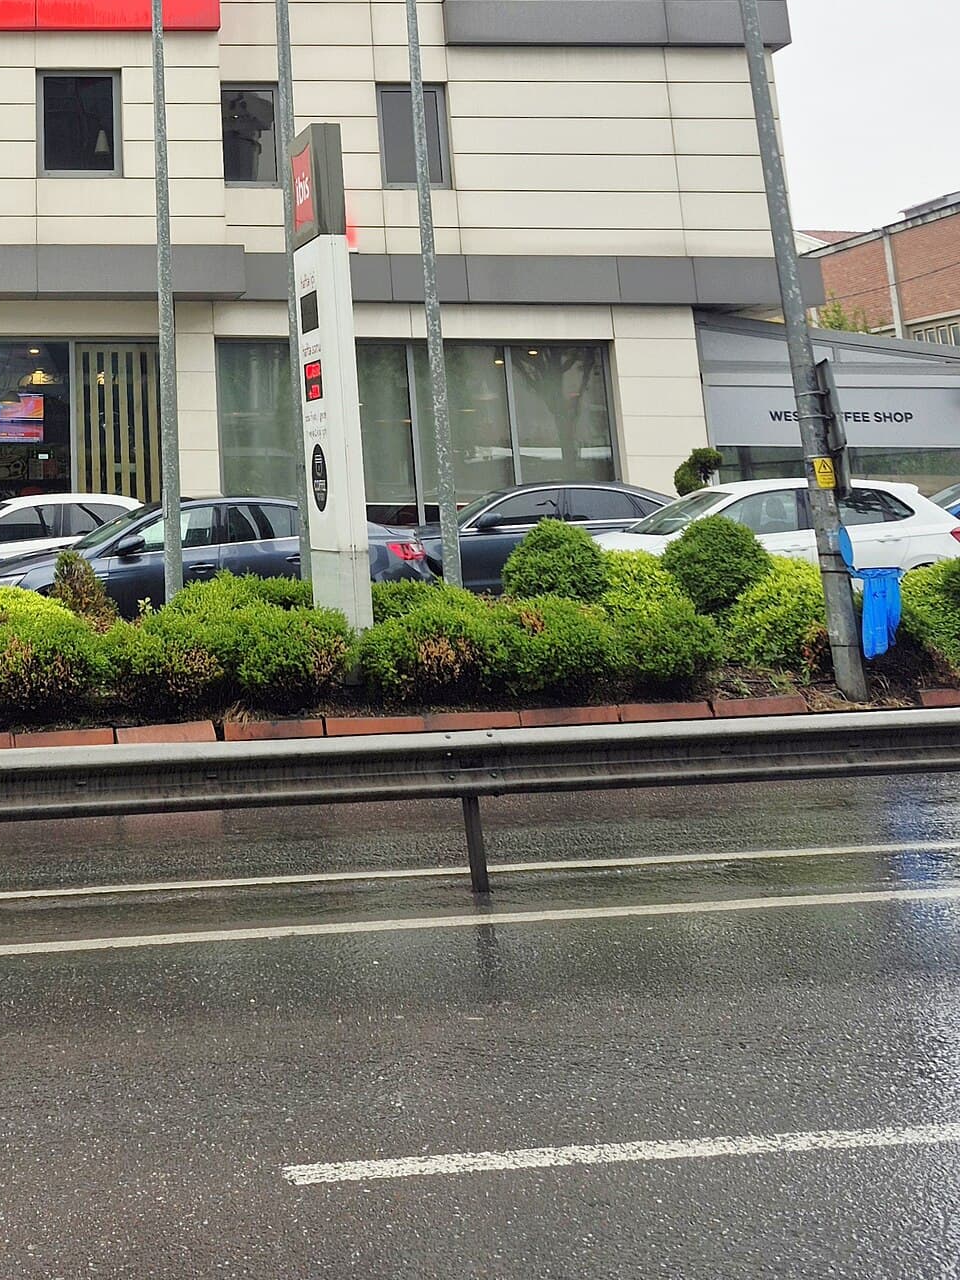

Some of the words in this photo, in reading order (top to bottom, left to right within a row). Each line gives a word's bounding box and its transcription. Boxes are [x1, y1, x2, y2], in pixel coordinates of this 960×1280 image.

[296, 172, 310, 207] ibis
[769, 410, 799, 422] WES
[873, 411, 914, 423] SHOP
